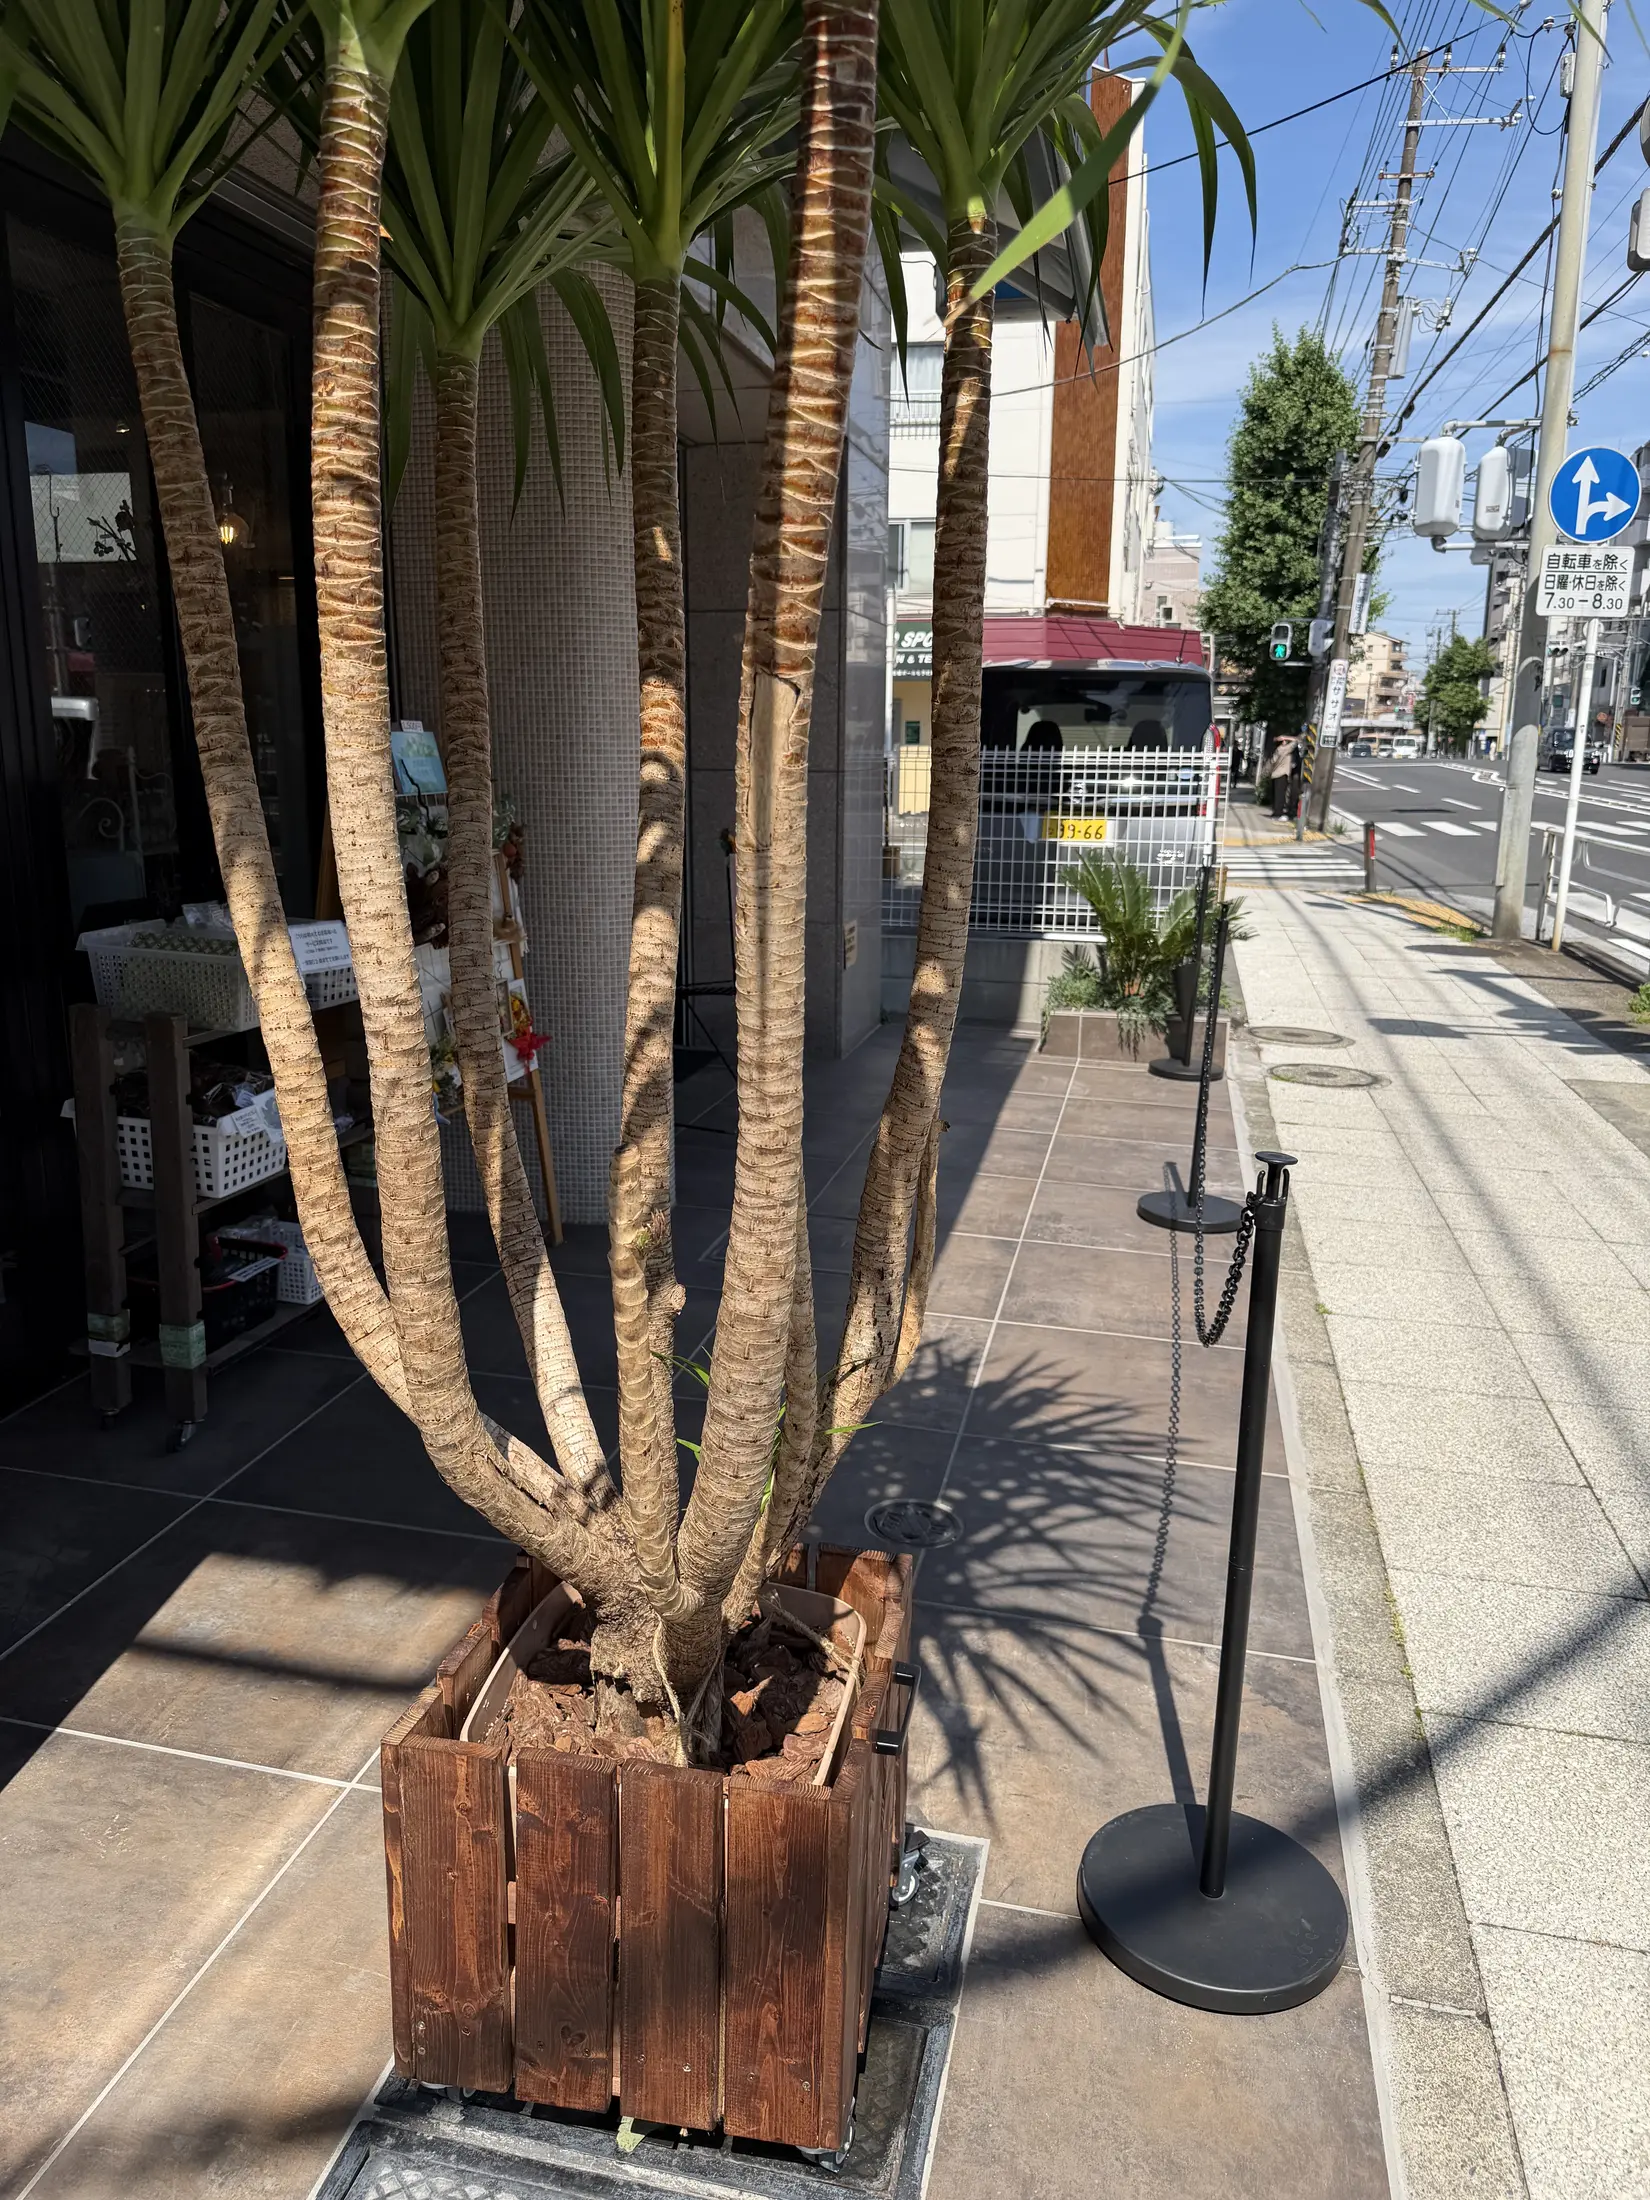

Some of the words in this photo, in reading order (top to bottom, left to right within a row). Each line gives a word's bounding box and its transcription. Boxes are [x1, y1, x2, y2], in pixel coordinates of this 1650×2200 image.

[1547, 553, 1628, 570] 自転車を除く
